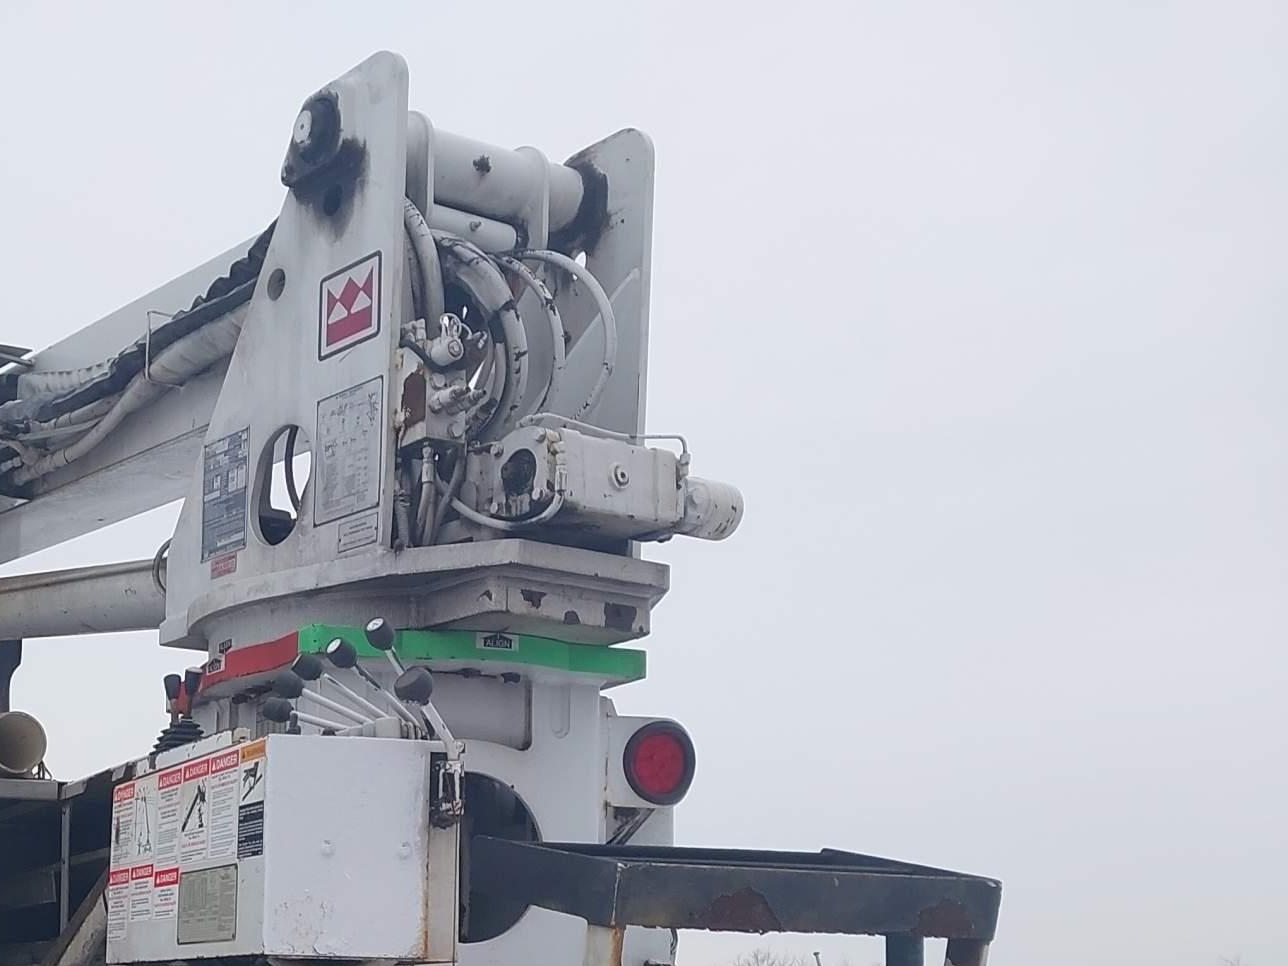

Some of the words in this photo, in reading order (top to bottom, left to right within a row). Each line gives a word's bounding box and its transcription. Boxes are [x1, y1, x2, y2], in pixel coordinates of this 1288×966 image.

[484, 638, 511, 648] ALIGN
[217, 754, 238, 769] DANGER
[189, 764, 208, 777] DANGER
[162, 771, 181, 785] DANGER
[135, 866, 152, 878] DANGER
[159, 871, 177, 882] DANGER
